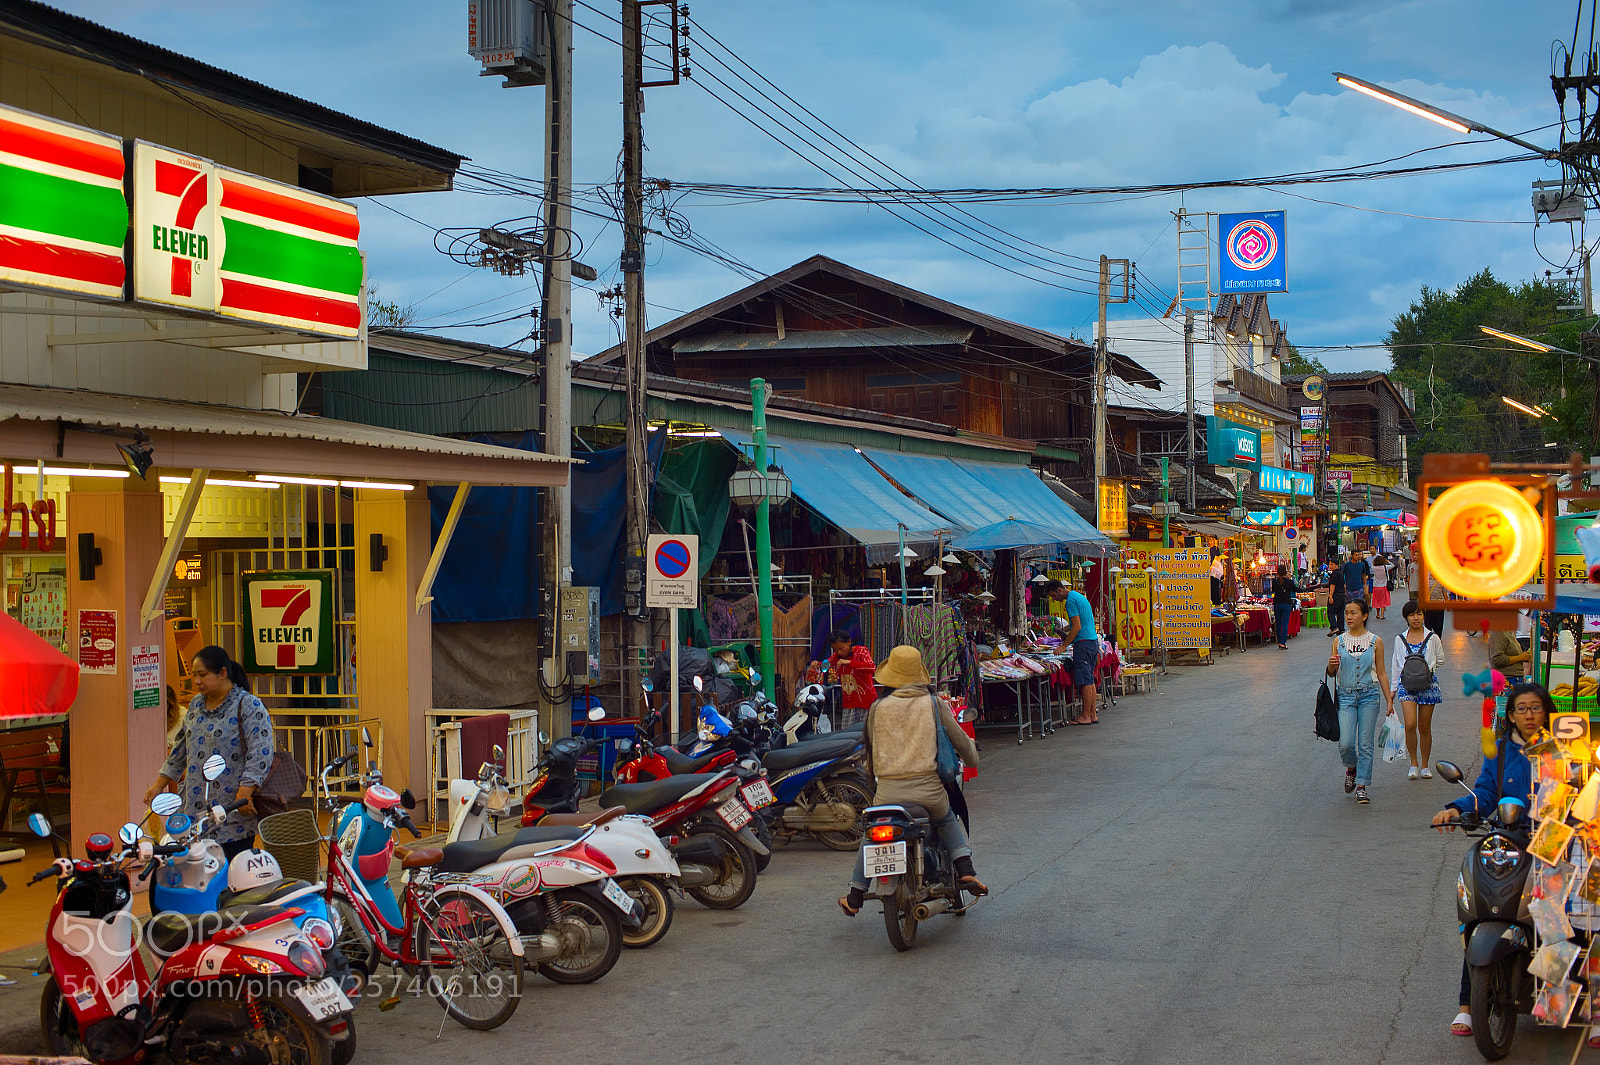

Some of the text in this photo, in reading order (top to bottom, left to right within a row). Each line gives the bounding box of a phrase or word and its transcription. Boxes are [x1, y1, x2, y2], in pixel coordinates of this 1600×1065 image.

[187, 570, 201, 580] atm
[1556, 716, 1584, 739] 5
[247, 855, 275, 872] AYA
[874, 864, 896, 874] 636
[320, 1001, 343, 1016] 607
